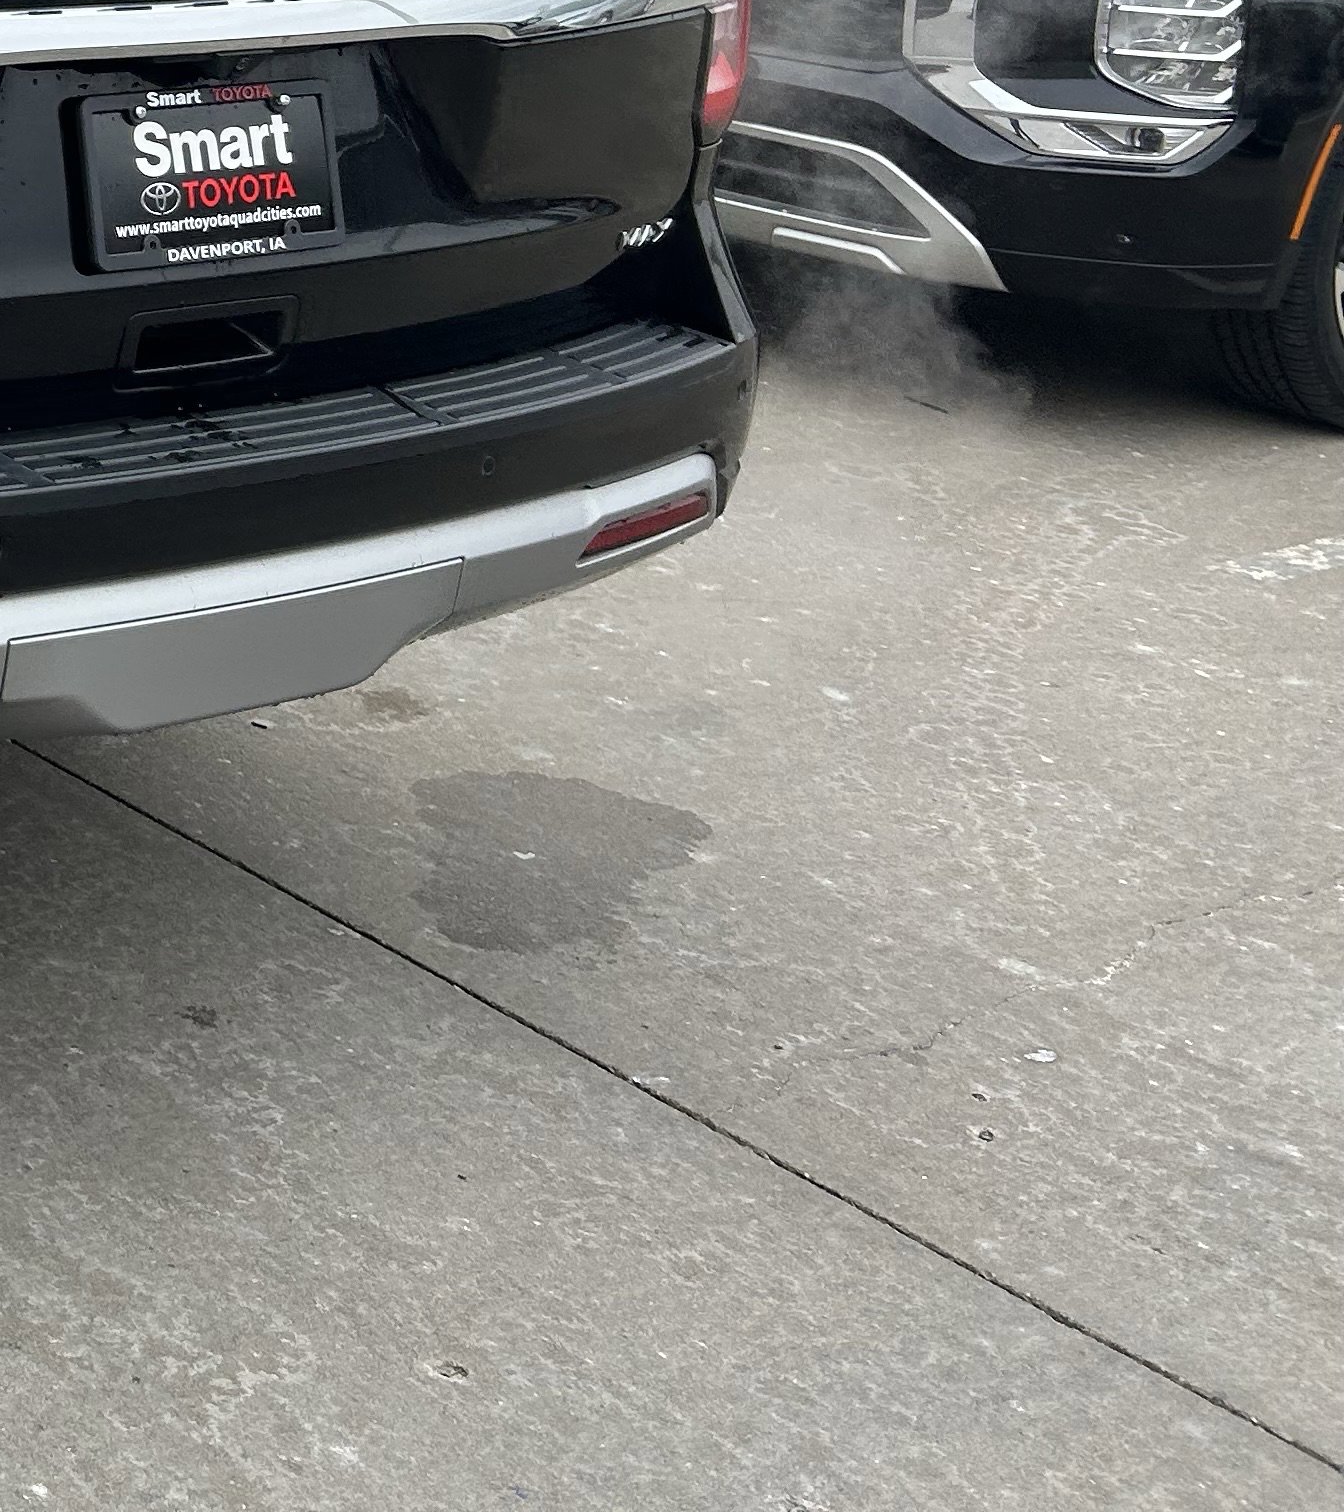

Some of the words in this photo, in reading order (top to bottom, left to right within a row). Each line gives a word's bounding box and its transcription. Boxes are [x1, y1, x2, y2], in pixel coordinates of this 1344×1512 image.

[146, 89, 202, 109] Smart
[212, 83, 273, 102] TOYOTA
[133, 114, 294, 178] Smart
[182, 171, 296, 209] TOYOTA
[115, 204, 322, 238] www.smarttoyotaquadcities.com
[167, 240, 265, 263] DAVENPORT,
[269, 237, 286, 251] IA
